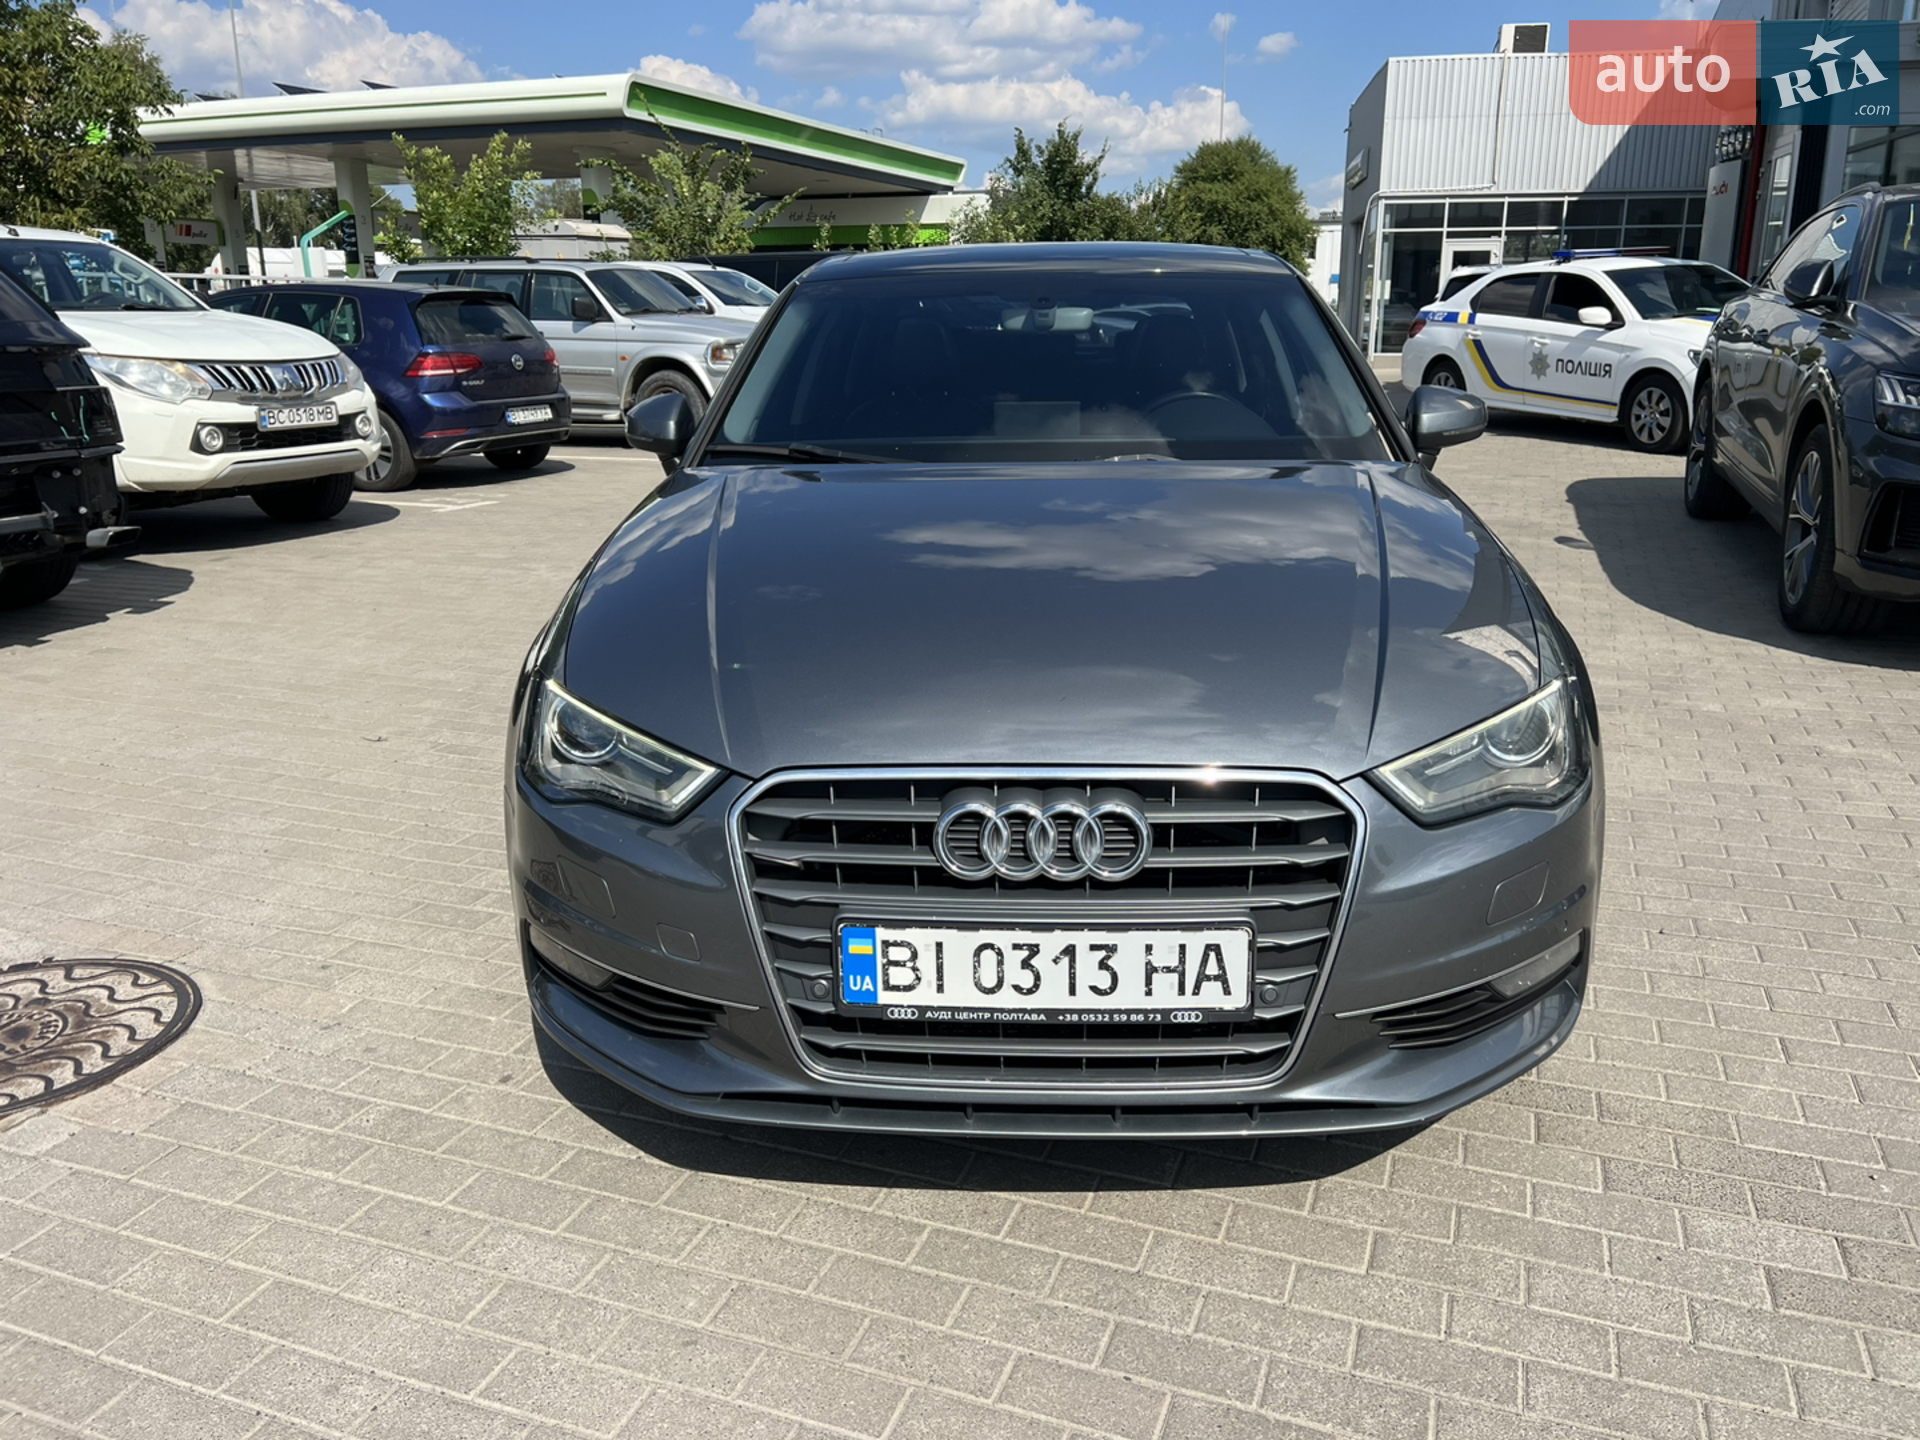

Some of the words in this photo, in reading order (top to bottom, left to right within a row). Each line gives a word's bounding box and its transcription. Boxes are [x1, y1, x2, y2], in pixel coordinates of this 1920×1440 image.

[1555, 358, 1612, 379] ПОЛІЦІЯ
[288, 407, 315, 424] 0518
[881, 939, 945, 994] BI
[972, 942, 1120, 997] 0313
[1144, 943, 1233, 997] HA
[849, 976, 874, 992] UA
[925, 1011, 952, 1020] АУДІ
[954, 1011, 991, 1020] ЦЕНТР
[994, 1012, 1047, 1021] ПОЛТАВА
[1057, 1013, 1079, 1022] +38
[1081, 1014, 1110, 1022] 0532
[1113, 1014, 1127, 1022] 59
[1130, 1014, 1145, 1022] 86
[1147, 1014, 1161, 1022] 73
